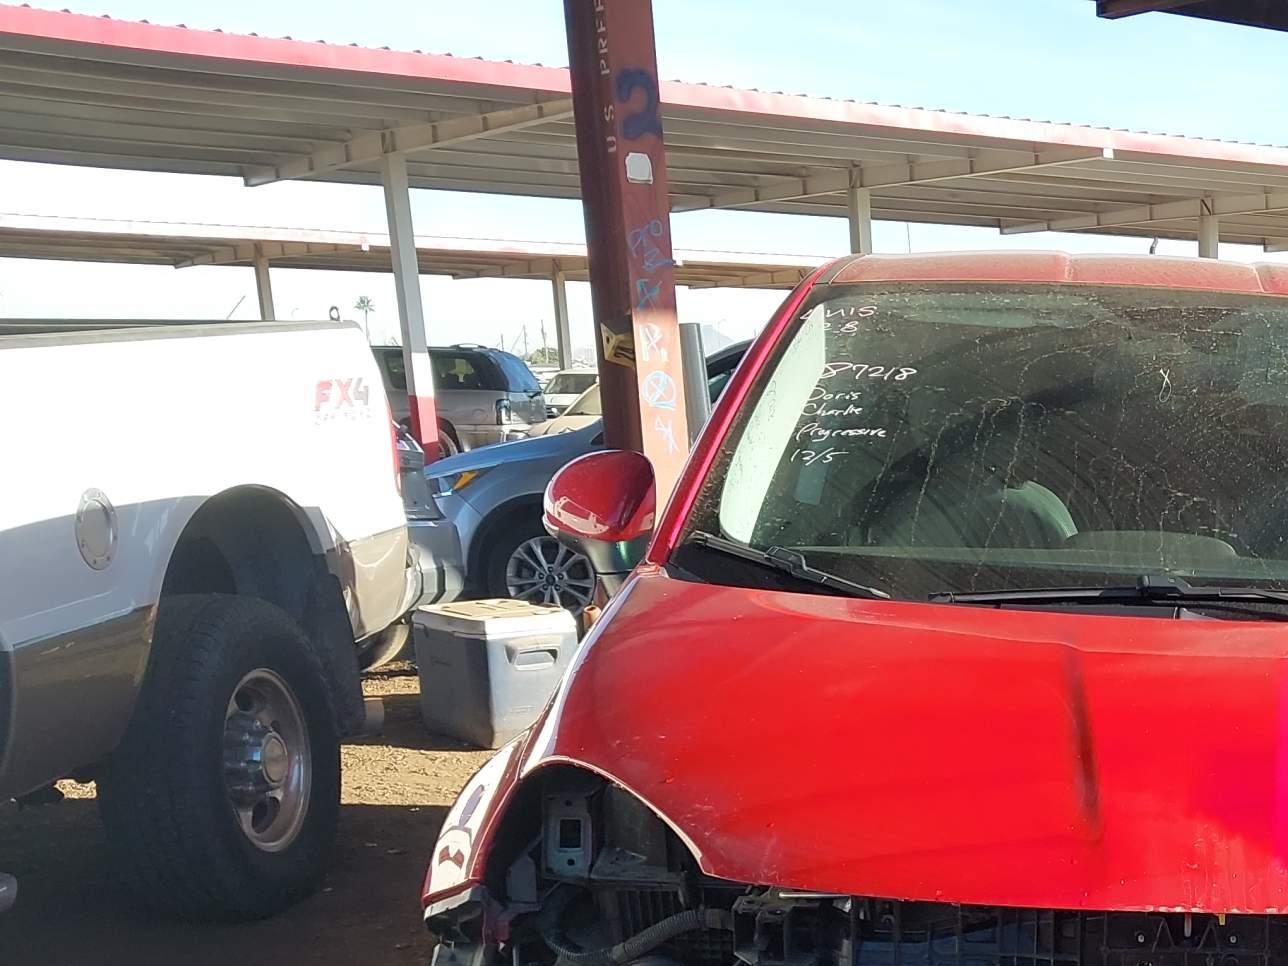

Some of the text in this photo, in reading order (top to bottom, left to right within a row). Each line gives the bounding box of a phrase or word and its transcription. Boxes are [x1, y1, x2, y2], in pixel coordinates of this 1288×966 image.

[314, 377, 369, 411] FX4
[808, 387, 862, 401] Doris
[790, 447, 849, 466] 12/5
